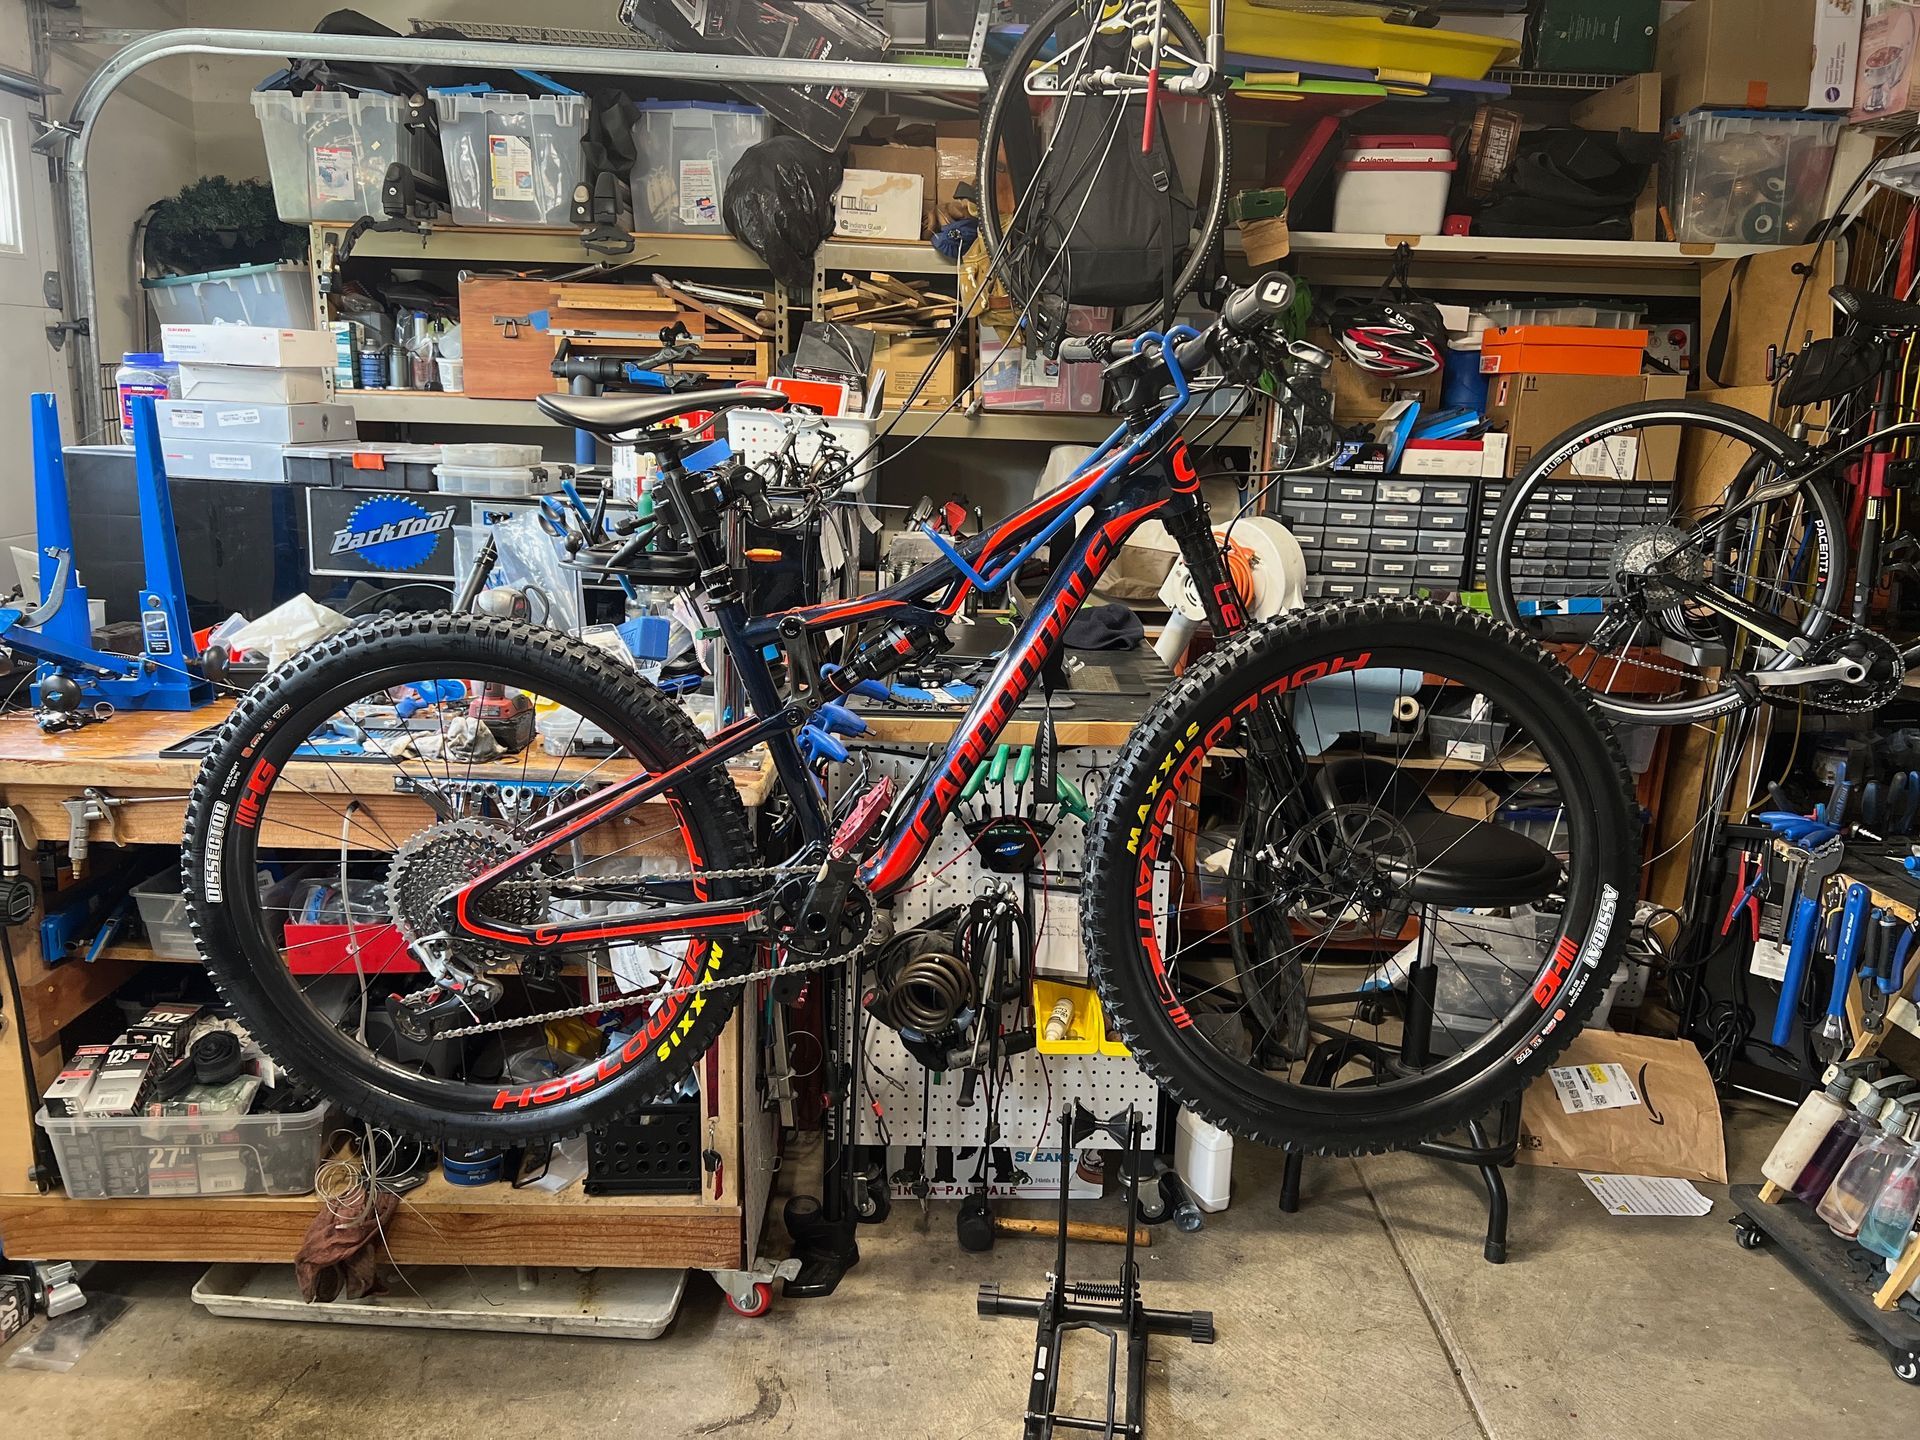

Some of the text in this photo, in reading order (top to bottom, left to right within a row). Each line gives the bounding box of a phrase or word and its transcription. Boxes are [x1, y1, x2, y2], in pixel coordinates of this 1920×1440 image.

[1540, 444, 1580, 477] PACENTI
[1814, 519, 1829, 573] PACENTI
[912, 530, 1117, 842] CANNONDALE
[1126, 720, 1201, 856] MAXXIS
[204, 800, 231, 903] DISSECTOR
[150, 1147, 190, 1169] 27"
